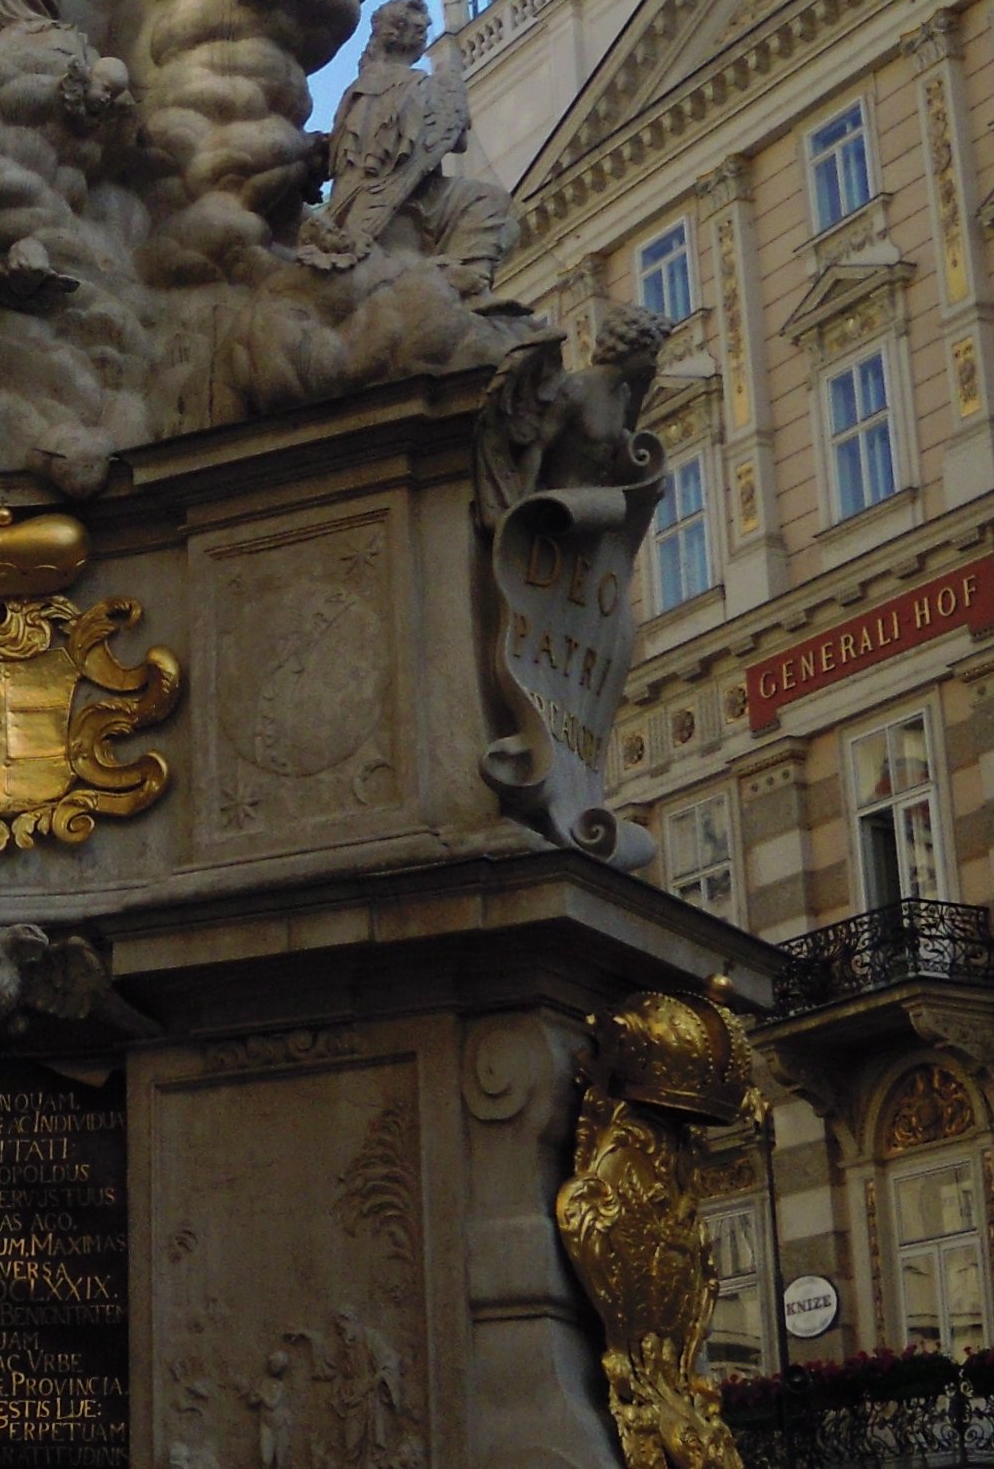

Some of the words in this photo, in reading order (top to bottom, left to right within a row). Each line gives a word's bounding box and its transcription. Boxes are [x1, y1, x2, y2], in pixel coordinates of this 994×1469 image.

[524, 535, 619, 617] DEO
[758, 611, 901, 700] GENERALI
[913, 574, 977, 629] HOF
